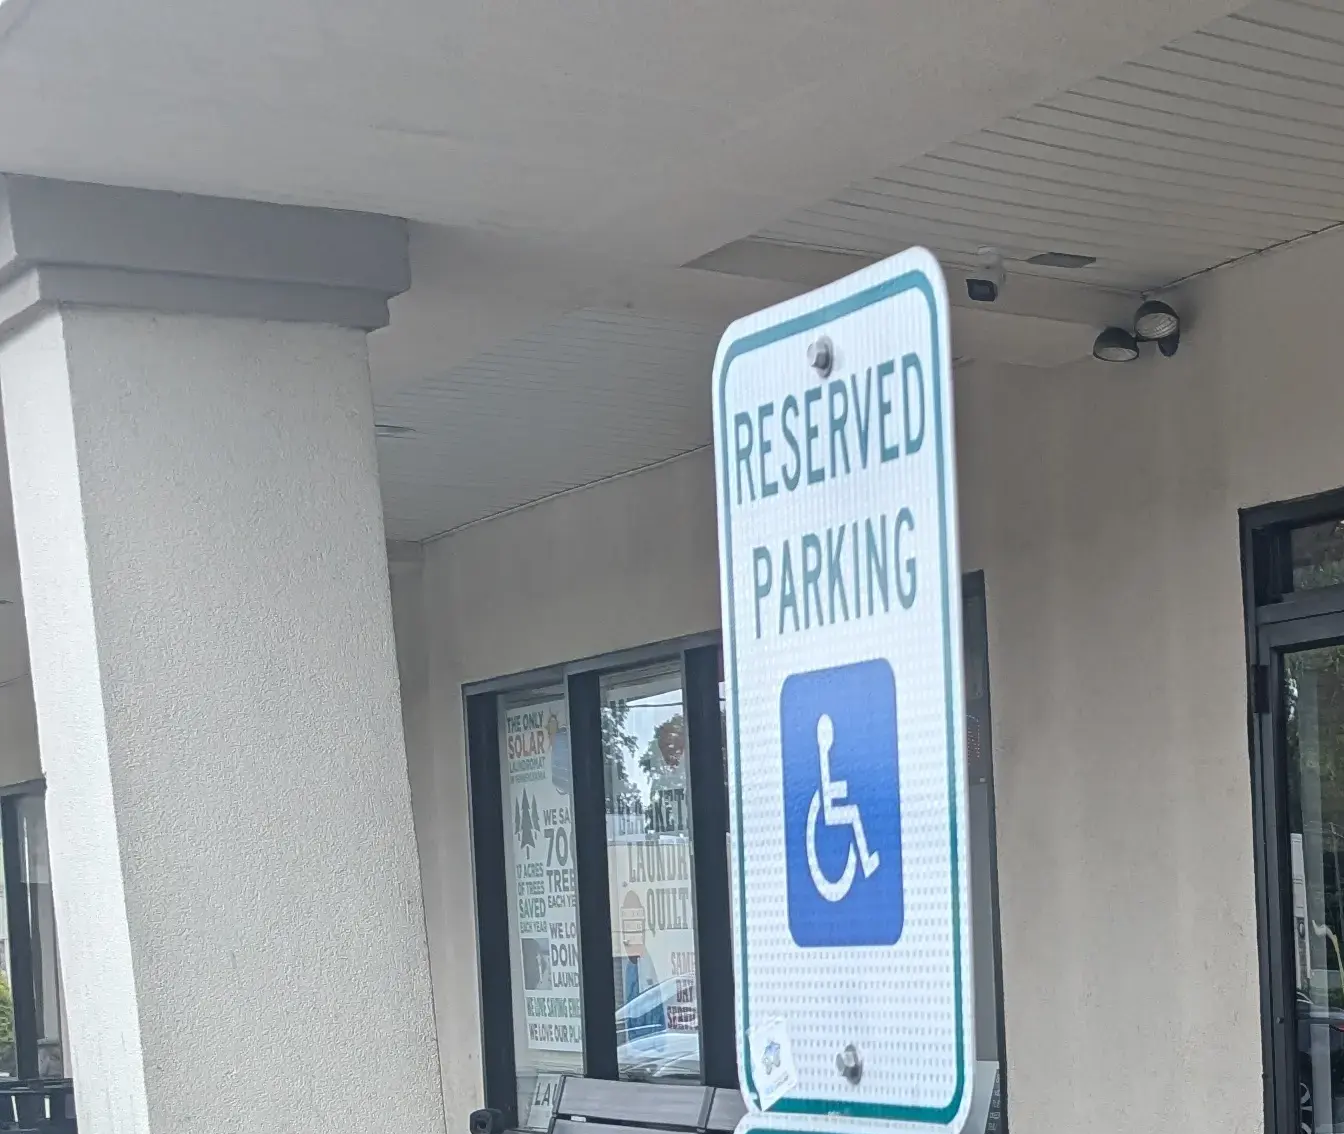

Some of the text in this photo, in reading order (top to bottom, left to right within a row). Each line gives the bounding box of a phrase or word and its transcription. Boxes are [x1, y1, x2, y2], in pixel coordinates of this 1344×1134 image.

[734, 352, 925, 505] RESERVED
[752, 506, 917, 639] PARKING
[508, 731, 545, 759] SOLAR
[543, 809, 557, 826] WE
[519, 898, 546, 919] SAVED
[646, 887, 689, 938] QUILT
[550, 923, 564, 939] WE
[554, 1024, 569, 1043] OUR
